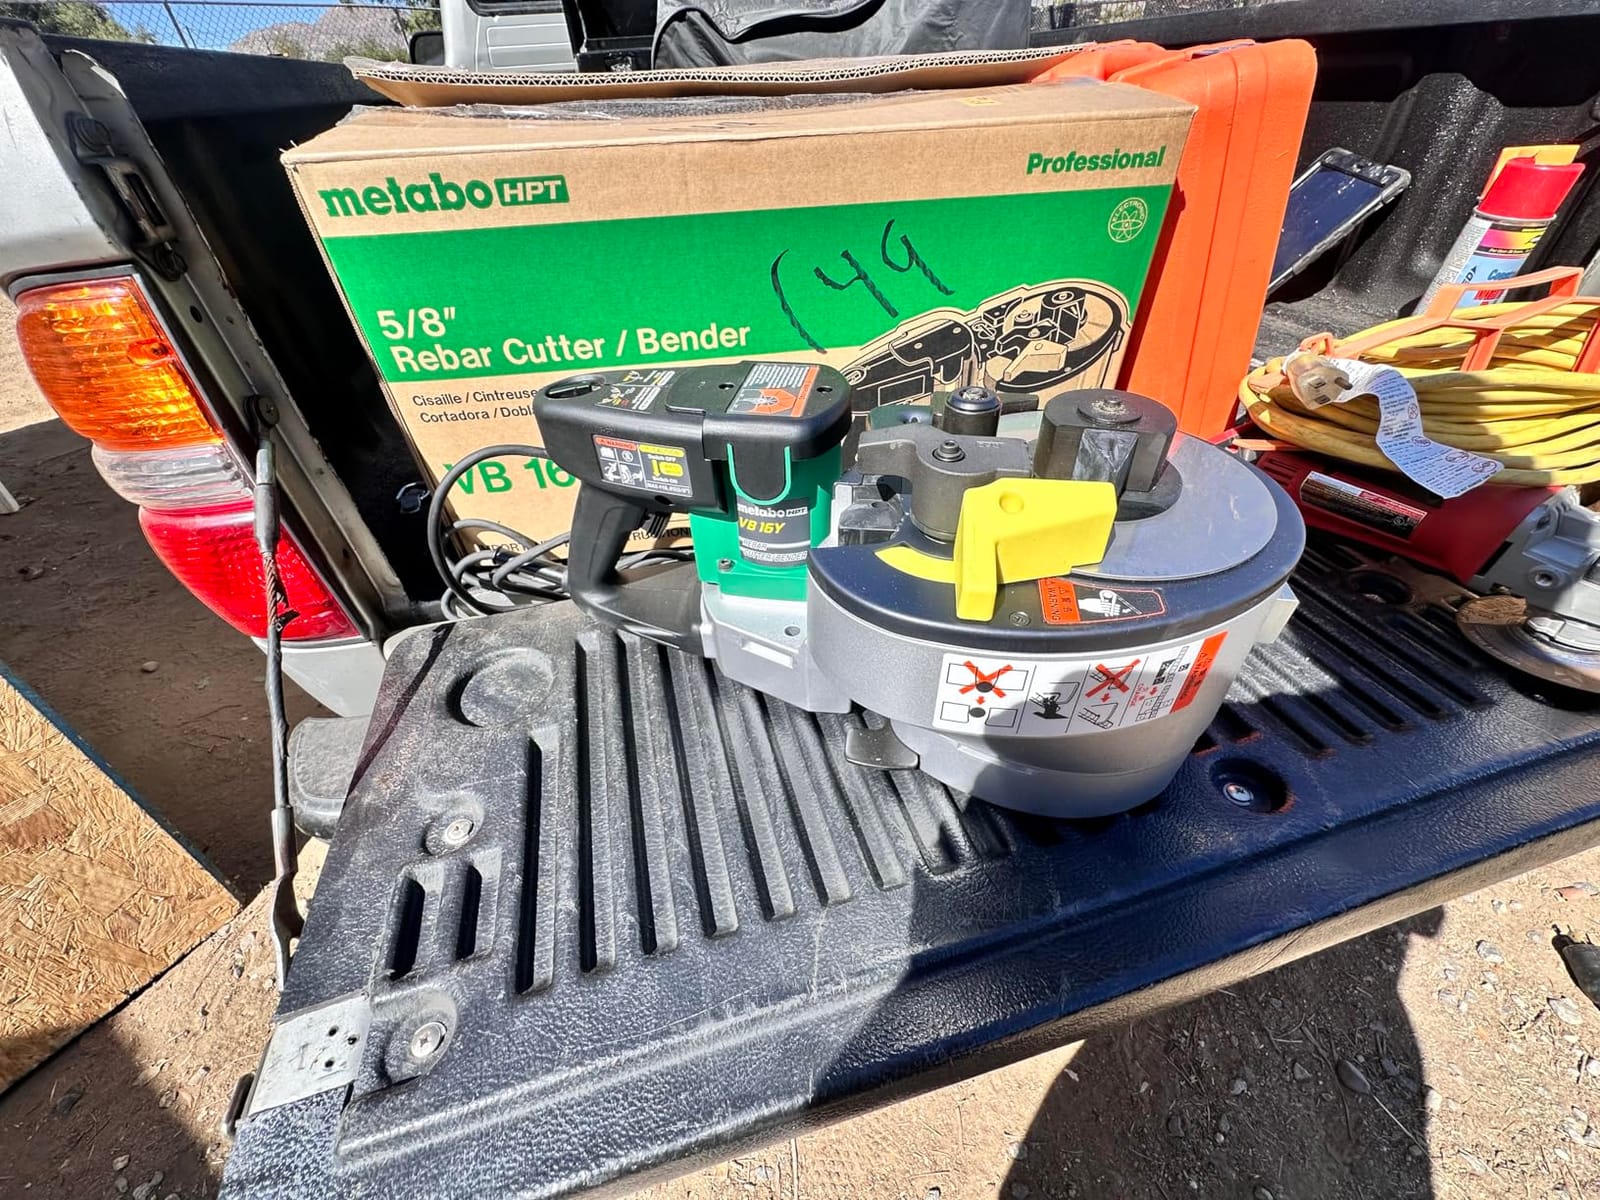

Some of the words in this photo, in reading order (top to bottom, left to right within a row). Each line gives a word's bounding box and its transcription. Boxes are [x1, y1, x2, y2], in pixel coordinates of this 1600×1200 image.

[1026, 145, 1166, 176] Professional
[318, 172, 493, 218] metabo
[502, 179, 562, 203] HPT
[376, 306, 457, 341] 5/8"
[389, 343, 493, 374] Rebar
[502, 334, 606, 366] Cutter
[616, 329, 628, 357] /
[636, 322, 751, 356] Bender
[412, 393, 462, 407] Cisaille
[465, 391, 470, 404] /
[472, 389, 538, 403] Cintreuse
[420, 410, 490, 423] Cortadora
[493, 407, 498, 419] /
[500, 405, 535, 418] Dobl
[737, 503, 785, 518] metabo
[786, 507, 808, 517] HPT
[739, 517, 757, 531] VB
[759, 521, 786, 534] 16Y
